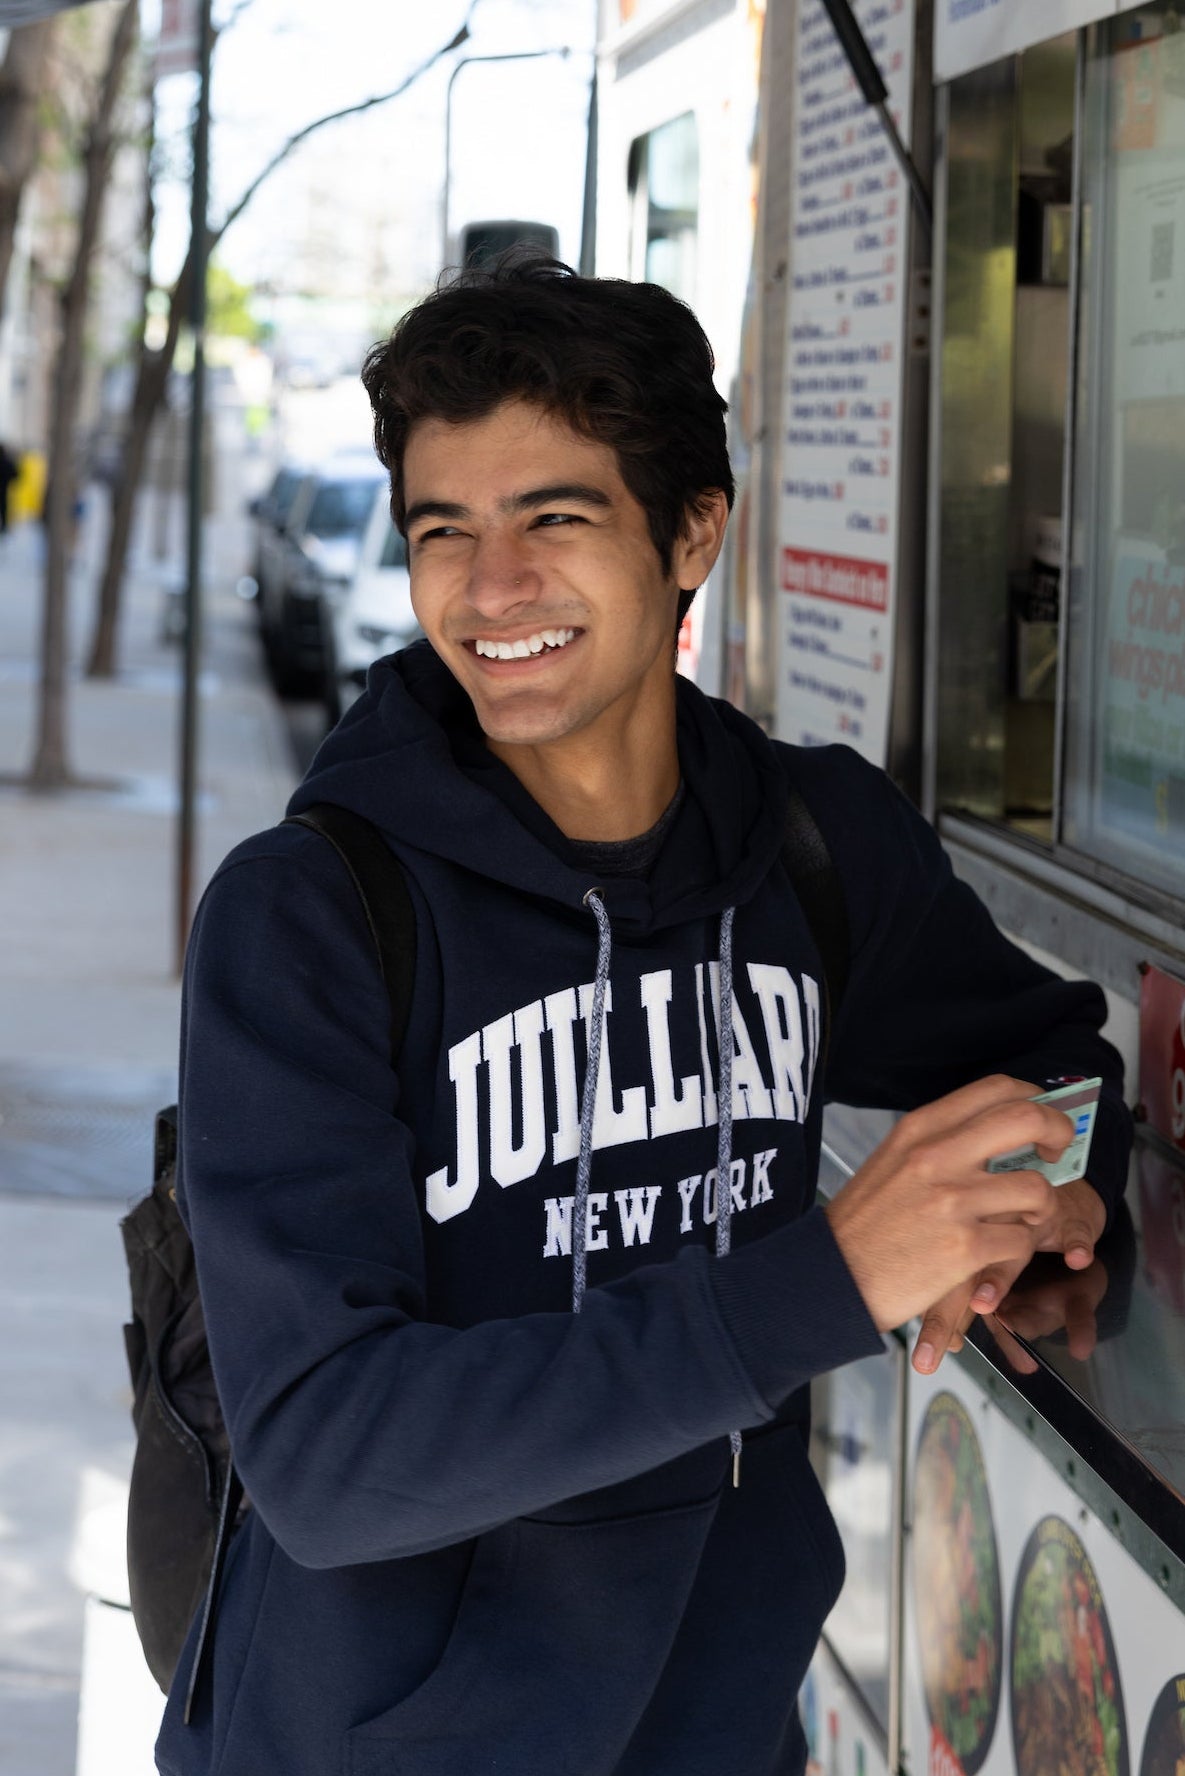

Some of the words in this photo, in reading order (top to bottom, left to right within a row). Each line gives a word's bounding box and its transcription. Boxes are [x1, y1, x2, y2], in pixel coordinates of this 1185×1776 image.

[426, 961, 820, 1225] JUILLIARD
[543, 1185, 662, 1258] NEW
[677, 1148, 778, 1234] YORK
